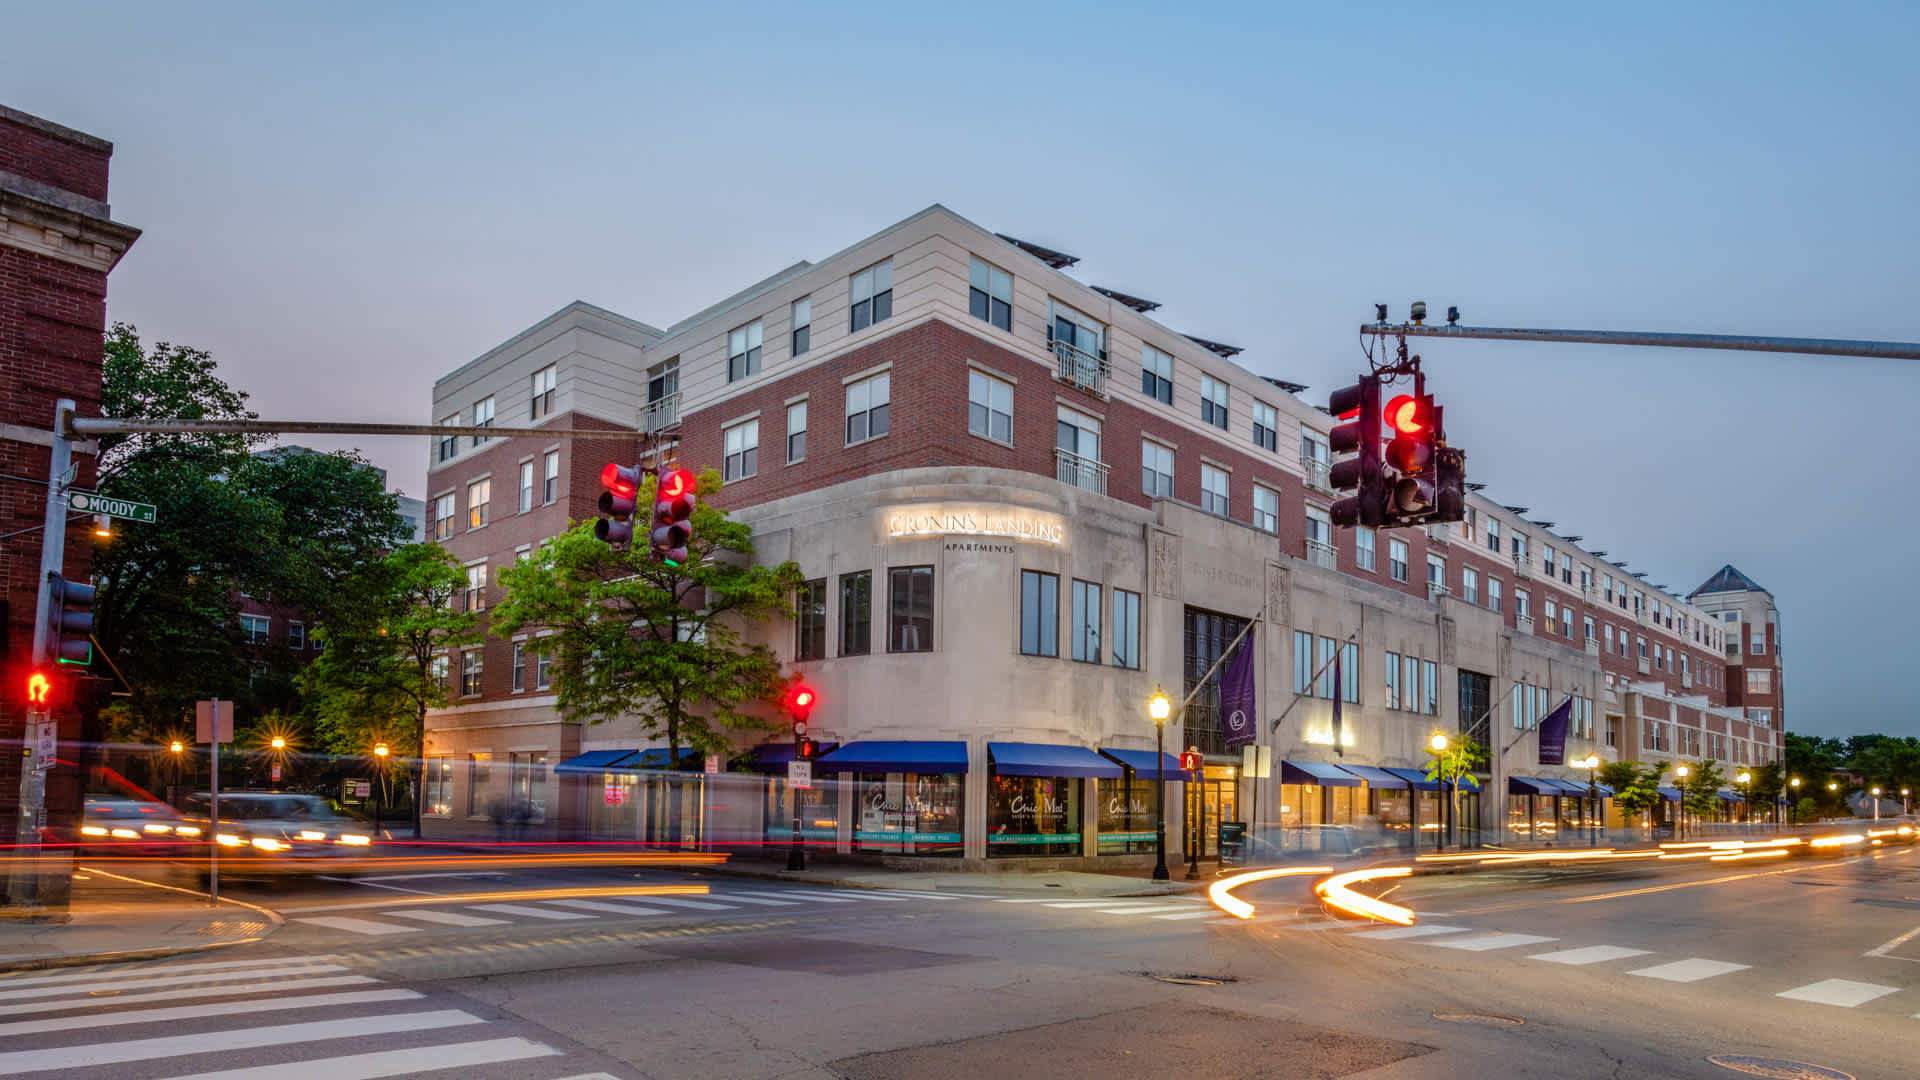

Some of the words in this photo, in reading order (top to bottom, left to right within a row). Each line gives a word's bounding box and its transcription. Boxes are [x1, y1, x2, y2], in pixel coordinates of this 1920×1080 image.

[89, 497, 137, 517] MOODY
[144, 511, 152, 521] ST
[983, 512, 1063, 543] LANDING
[944, 543, 1015, 554] APARTMENTS
[1010, 796, 1040, 815] Chic
[1109, 797, 1129, 814] Chic
